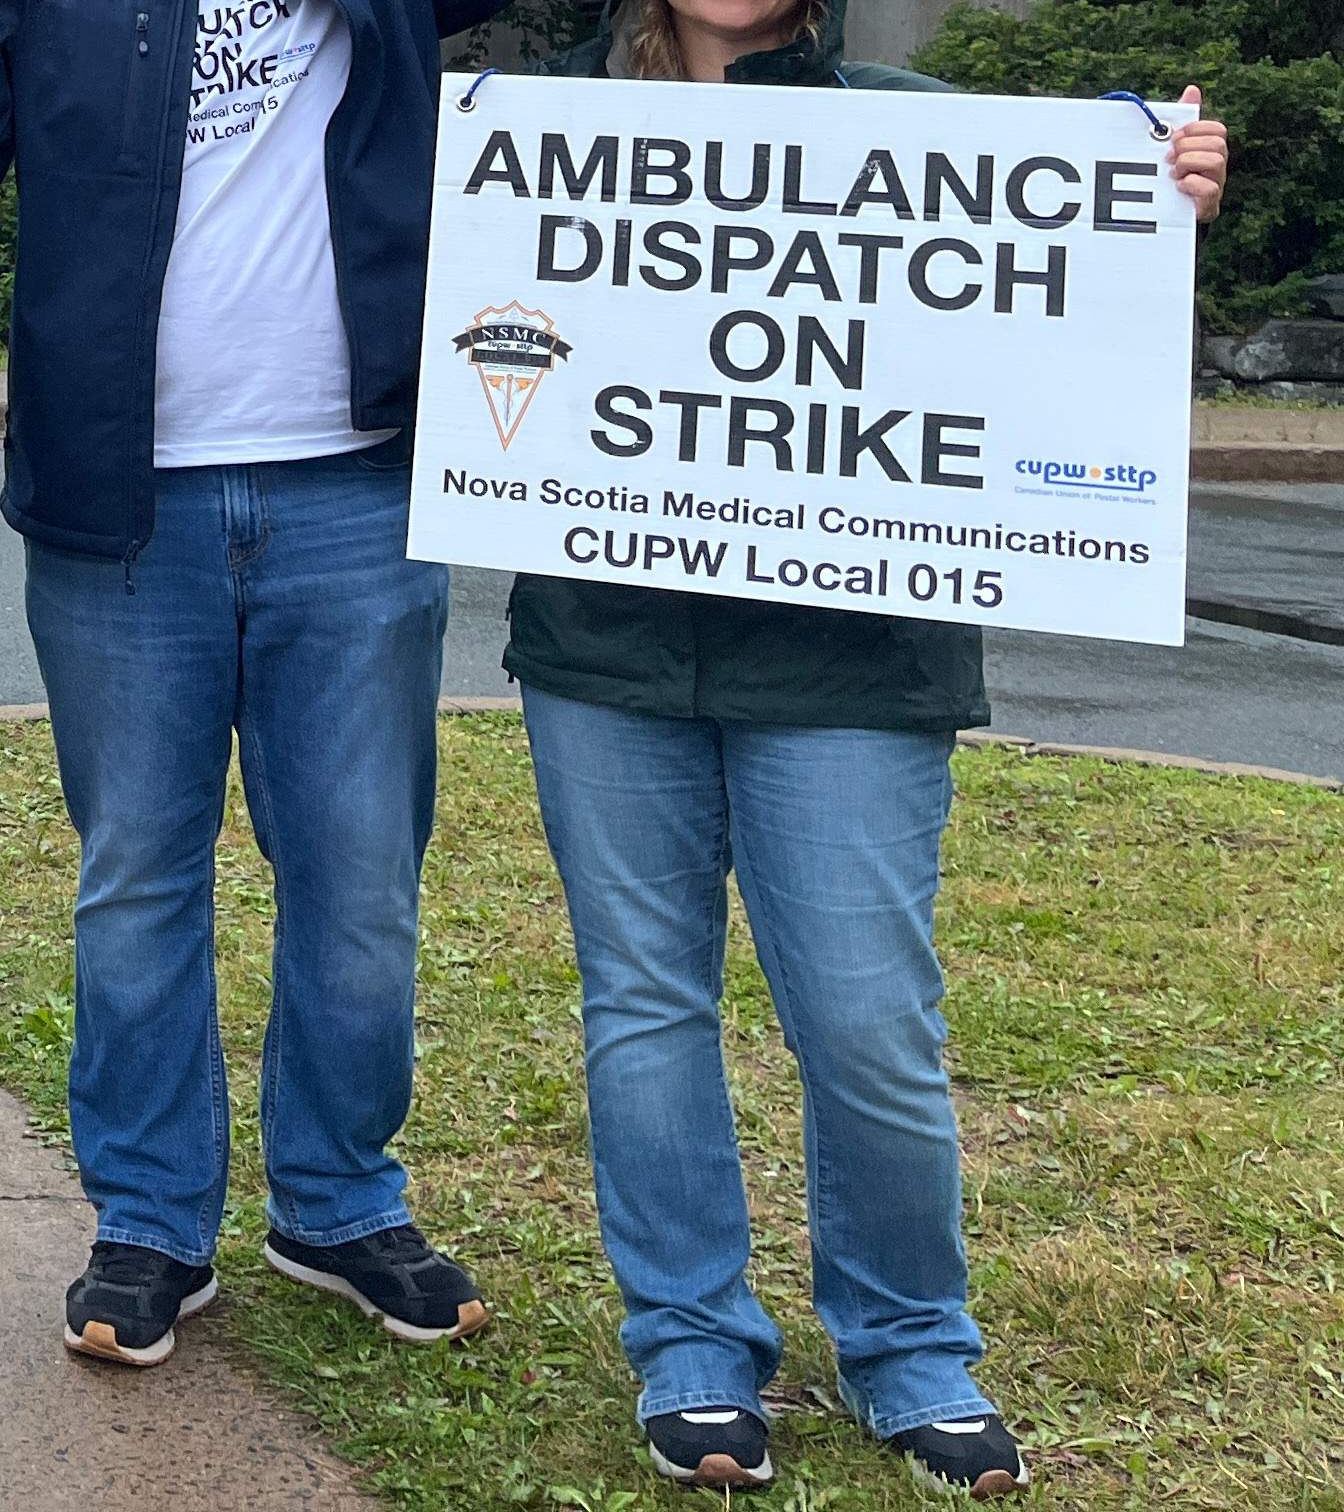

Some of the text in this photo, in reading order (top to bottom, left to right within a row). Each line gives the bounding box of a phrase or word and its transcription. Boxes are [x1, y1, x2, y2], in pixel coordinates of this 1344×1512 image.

[212, 118, 255, 140] Local
[462, 130, 1158, 234] AMBULANCE
[536, 214, 1067, 317] DISPATCH
[481, 326, 546, 343] NSMC
[709, 309, 865, 391] ON
[590, 385, 985, 490] STRIKE
[443, 468, 1149, 564] Nova Scotia Medical Communications
[564, 526, 1003, 608] CUPW Local 015
